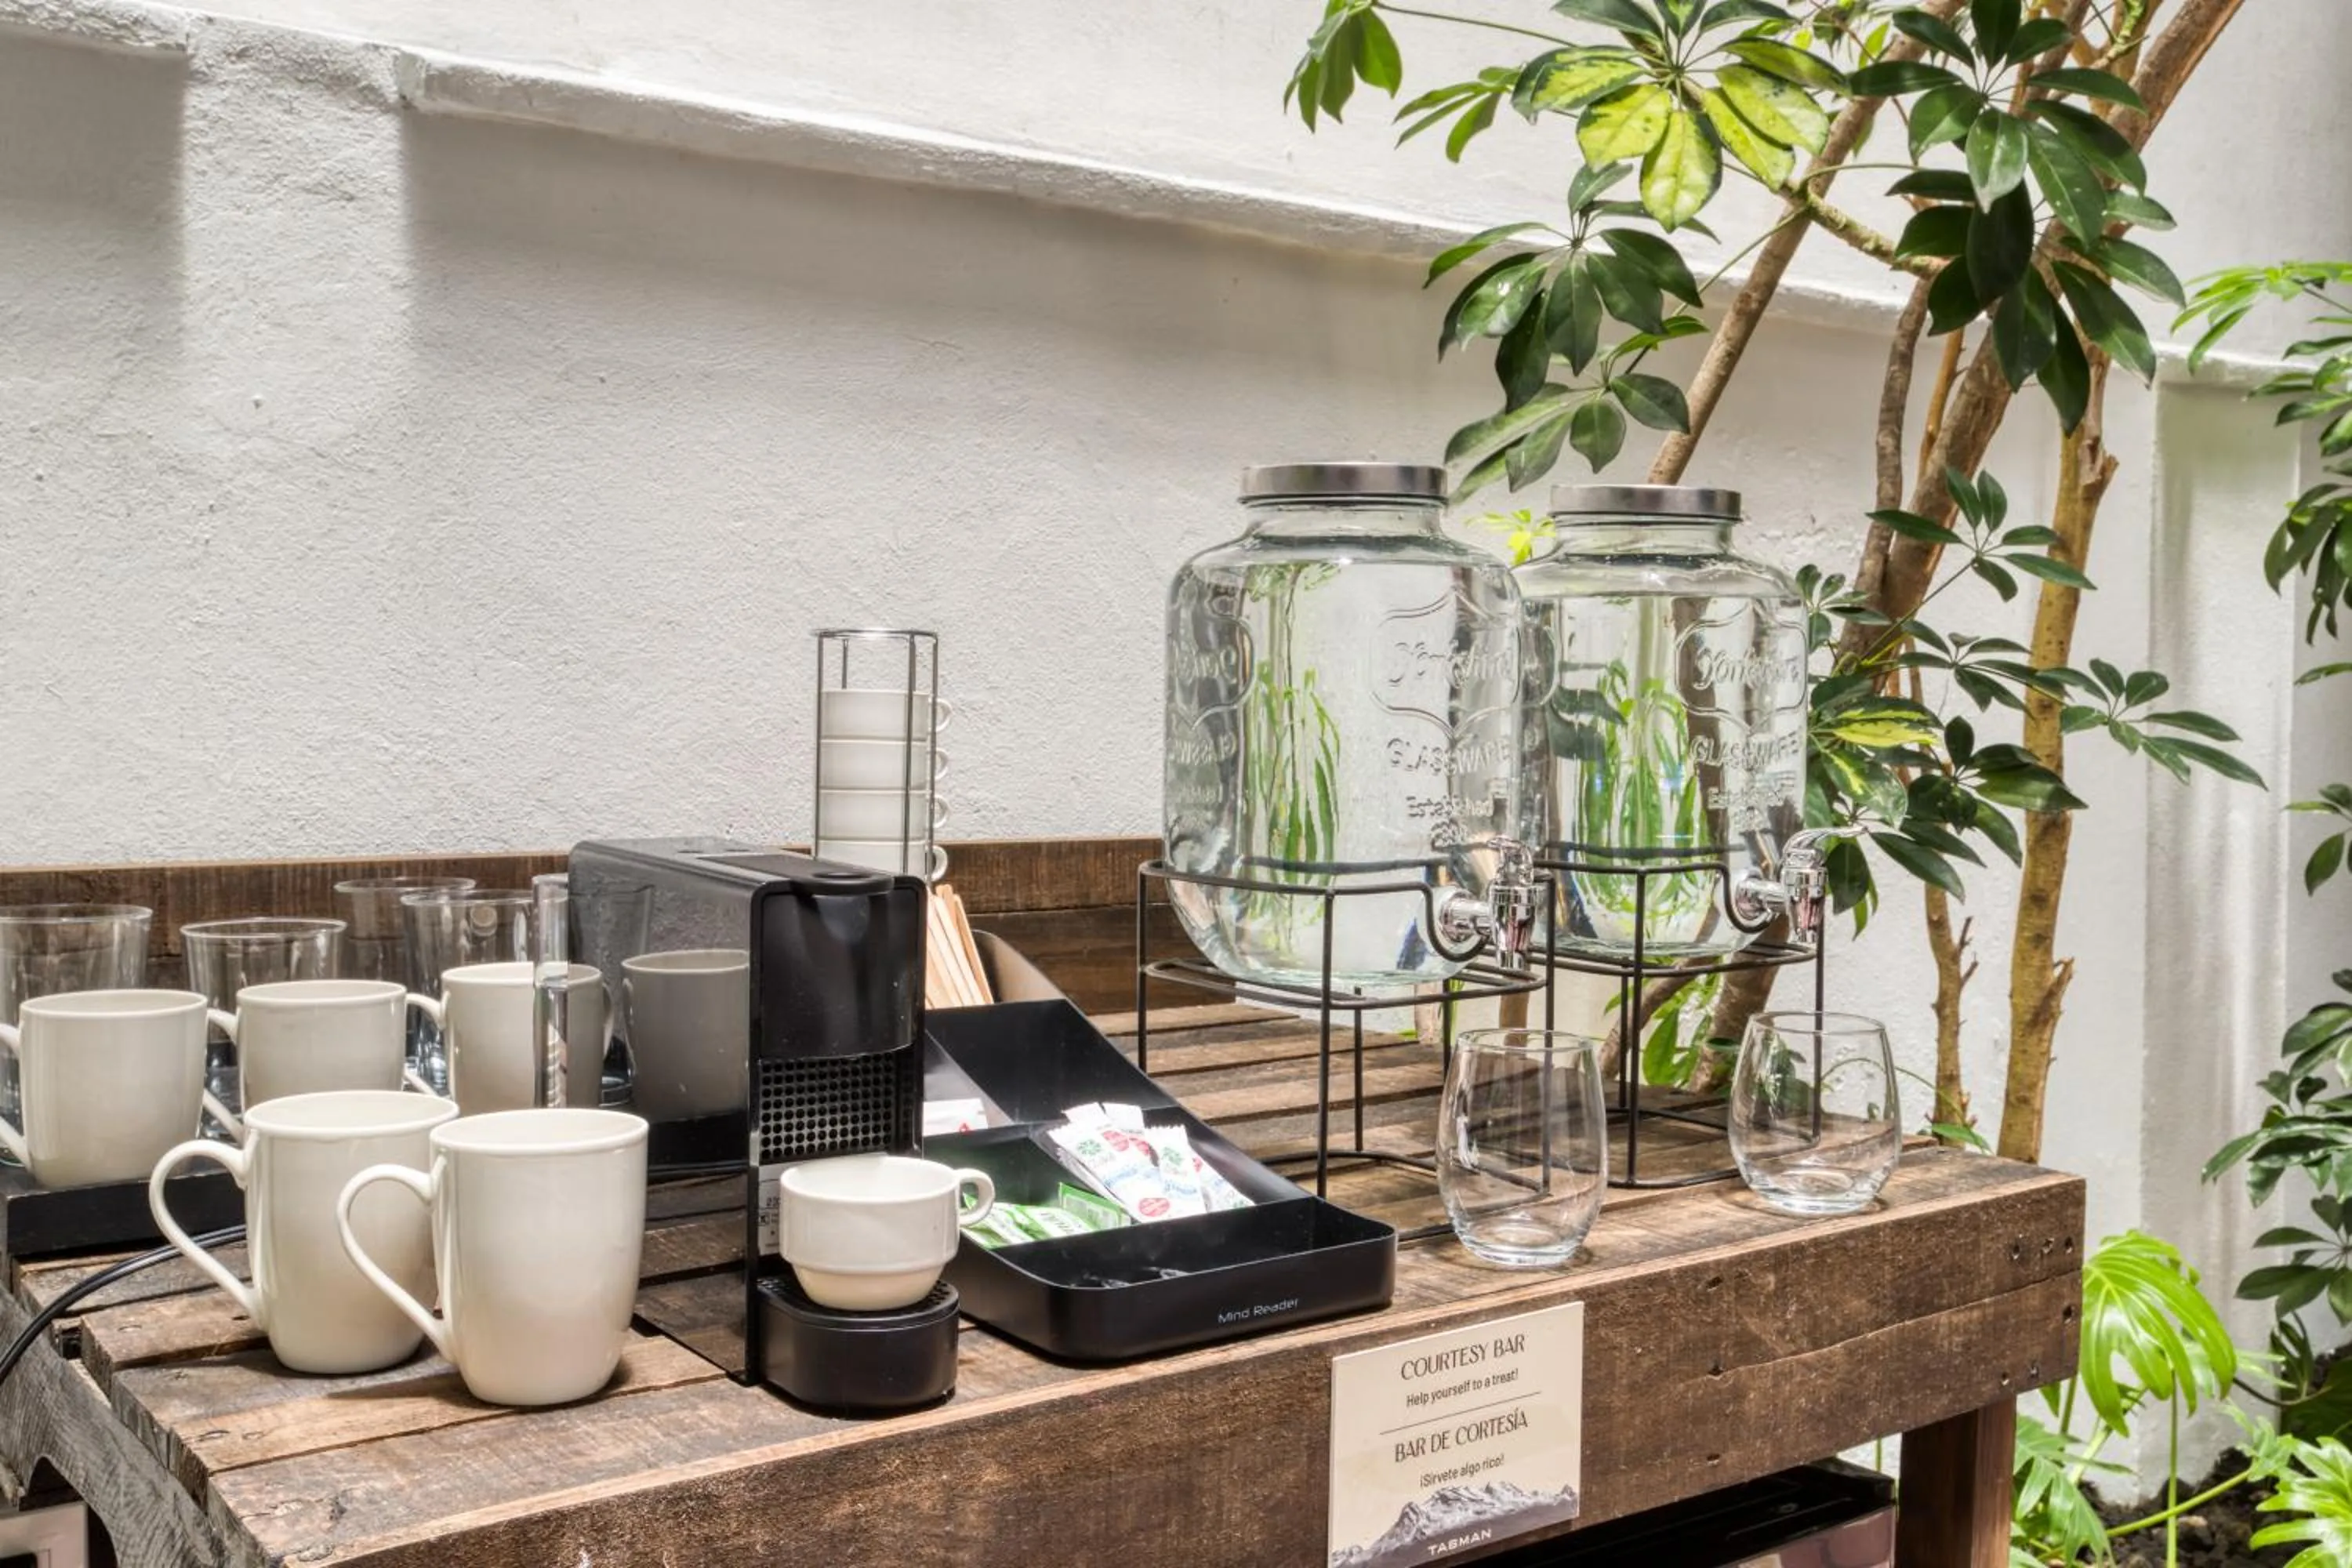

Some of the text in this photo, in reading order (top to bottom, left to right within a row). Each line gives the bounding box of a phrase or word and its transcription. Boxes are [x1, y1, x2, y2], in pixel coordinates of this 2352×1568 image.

[1218, 1298, 1298, 1324] Mind Reader
[1401, 1334, 1525, 1380] COURTESY BAR
[1406, 1368, 1519, 1408] Help yourself to a treat!
[1395, 1407, 1528, 1463] BAR DE CORTESÍA
[1460, 1461, 1481, 1477] algo
[1483, 1453, 1504, 1468] rico!
[1427, 1529, 1492, 1556] TASMAN
